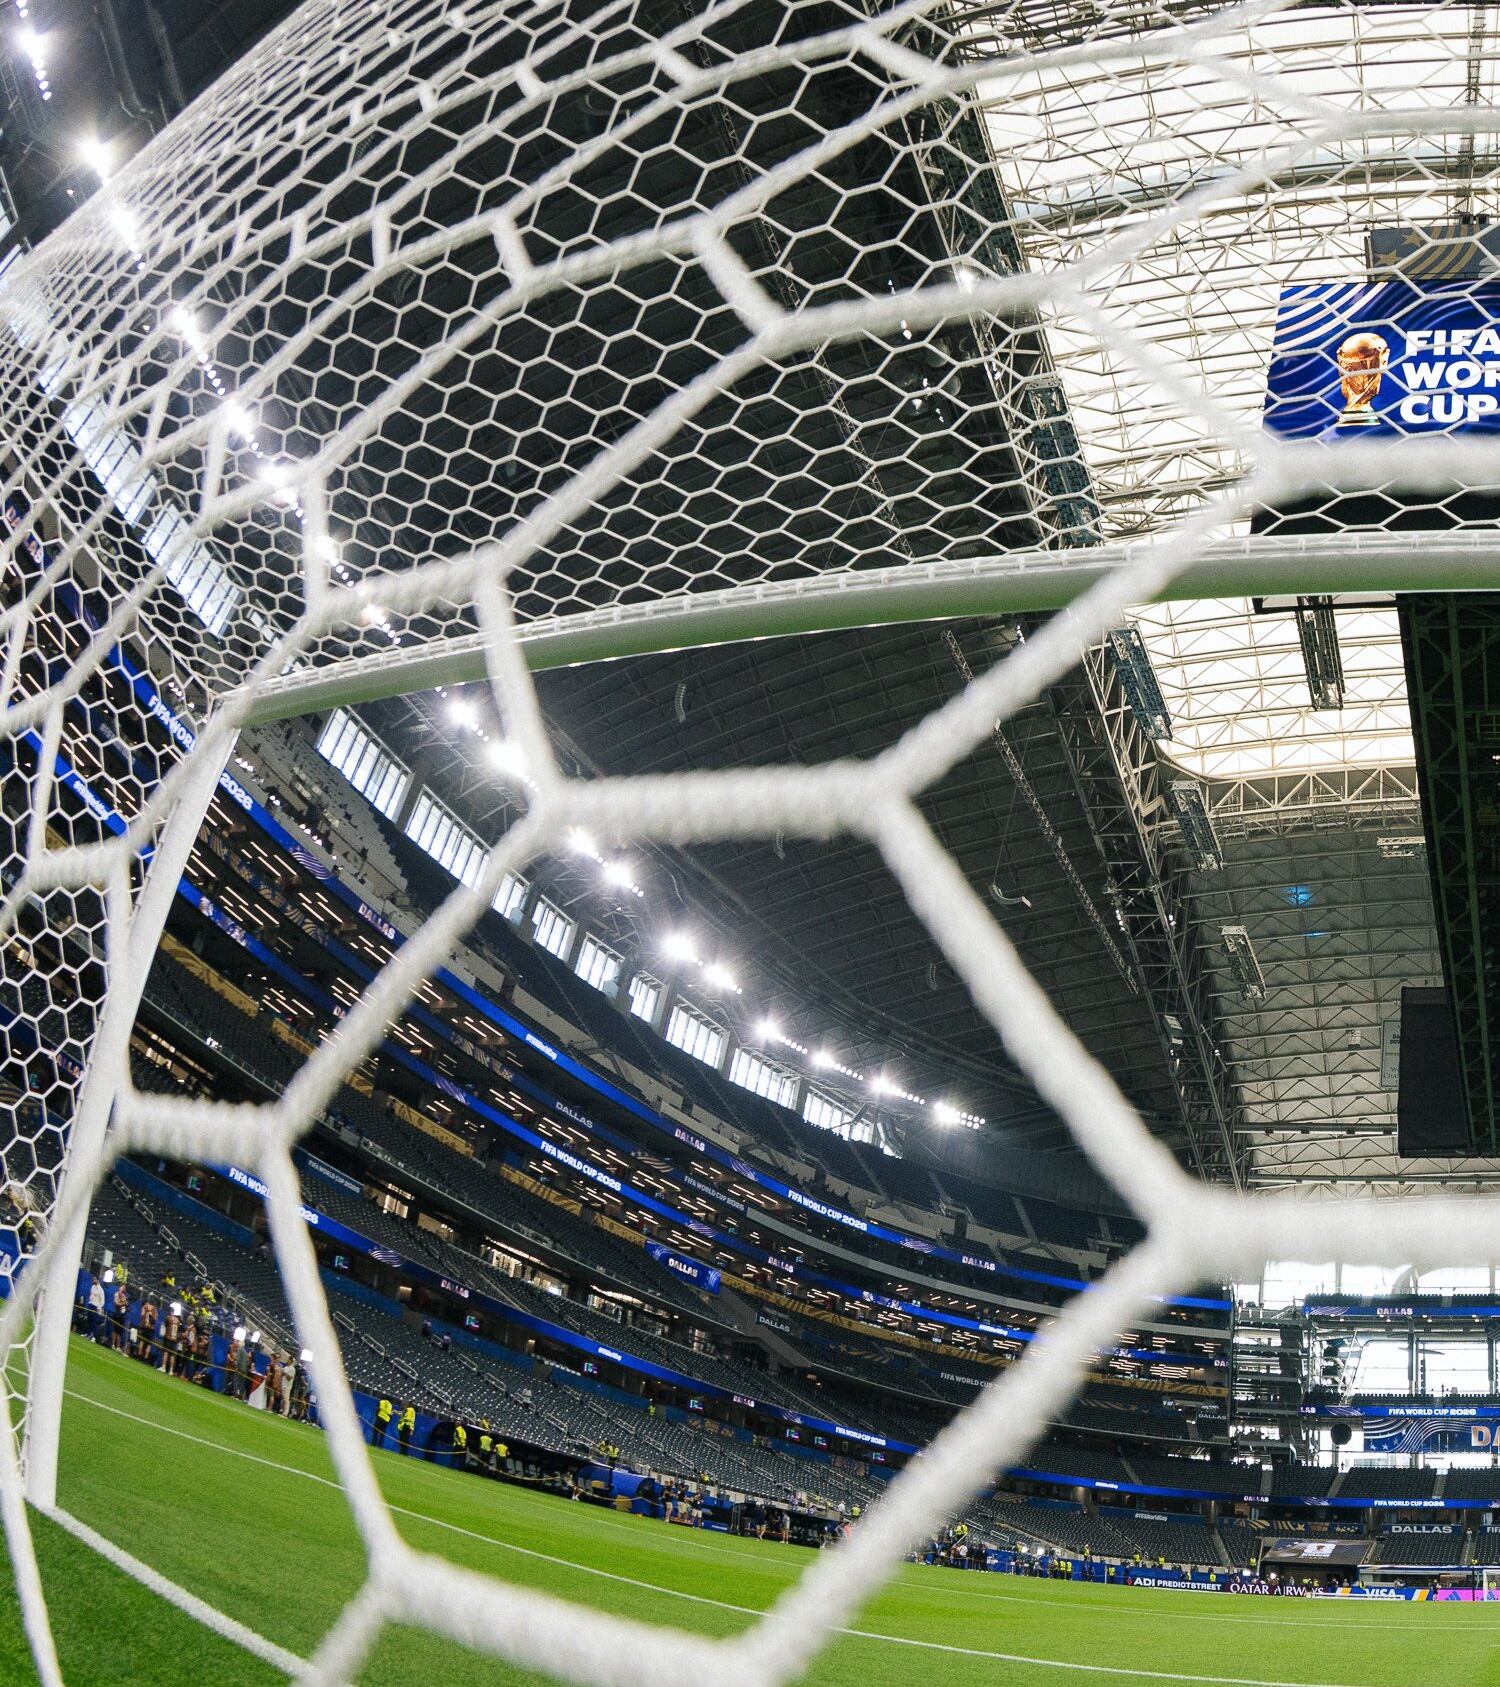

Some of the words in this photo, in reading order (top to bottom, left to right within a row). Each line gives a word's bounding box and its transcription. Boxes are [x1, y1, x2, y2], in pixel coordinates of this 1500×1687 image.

[1400, 394, 1497, 423] CUP
[358, 903, 396, 940] DALLAS
[556, 1102, 593, 1128] DALLAS
[675, 1129, 706, 1152] DALLAS
[541, 1141, 557, 1156] FIFA
[557, 1150, 583, 1171] WORLD
[582, 1163, 598, 1178] CUP
[597, 1173, 622, 1191] 2026
[229, 1168, 248, 1185] FIFA
[247, 1178, 273, 1200] WORL
[685, 1176, 697, 1187] FIFA
[697, 1181, 716, 1197] WORLD
[716, 1190, 727, 1201] CUP
[788, 1190, 803, 1204] FIFA
[803, 1195, 827, 1215] WORLD
[827, 1207, 842, 1220] CUP
[841, 1214, 868, 1231] 2026
[668, 1258, 698, 1278] DALLAS
[768, 1256, 794, 1274] DALLAS
[962, 1255, 996, 1271] DALLAS
[759, 1316, 790, 1333] DALLAS
[940, 1372, 955, 1381] FIFA
[956, 1375, 979, 1386] WORLD
[1388, 1408, 1405, 1416] FIFA
[1405, 1408, 1433, 1416] WORLD
[1433, 1408, 1449, 1416] CUP
[1391, 1525, 1453, 1533] DALLAS
[1134, 1577, 1156, 1587] ADI
[1157, 1580, 1222, 1591] PREDICTSTREET
[1230, 1583, 1269, 1595] QATAR
[1363, 1588, 1397, 1599] VISA
